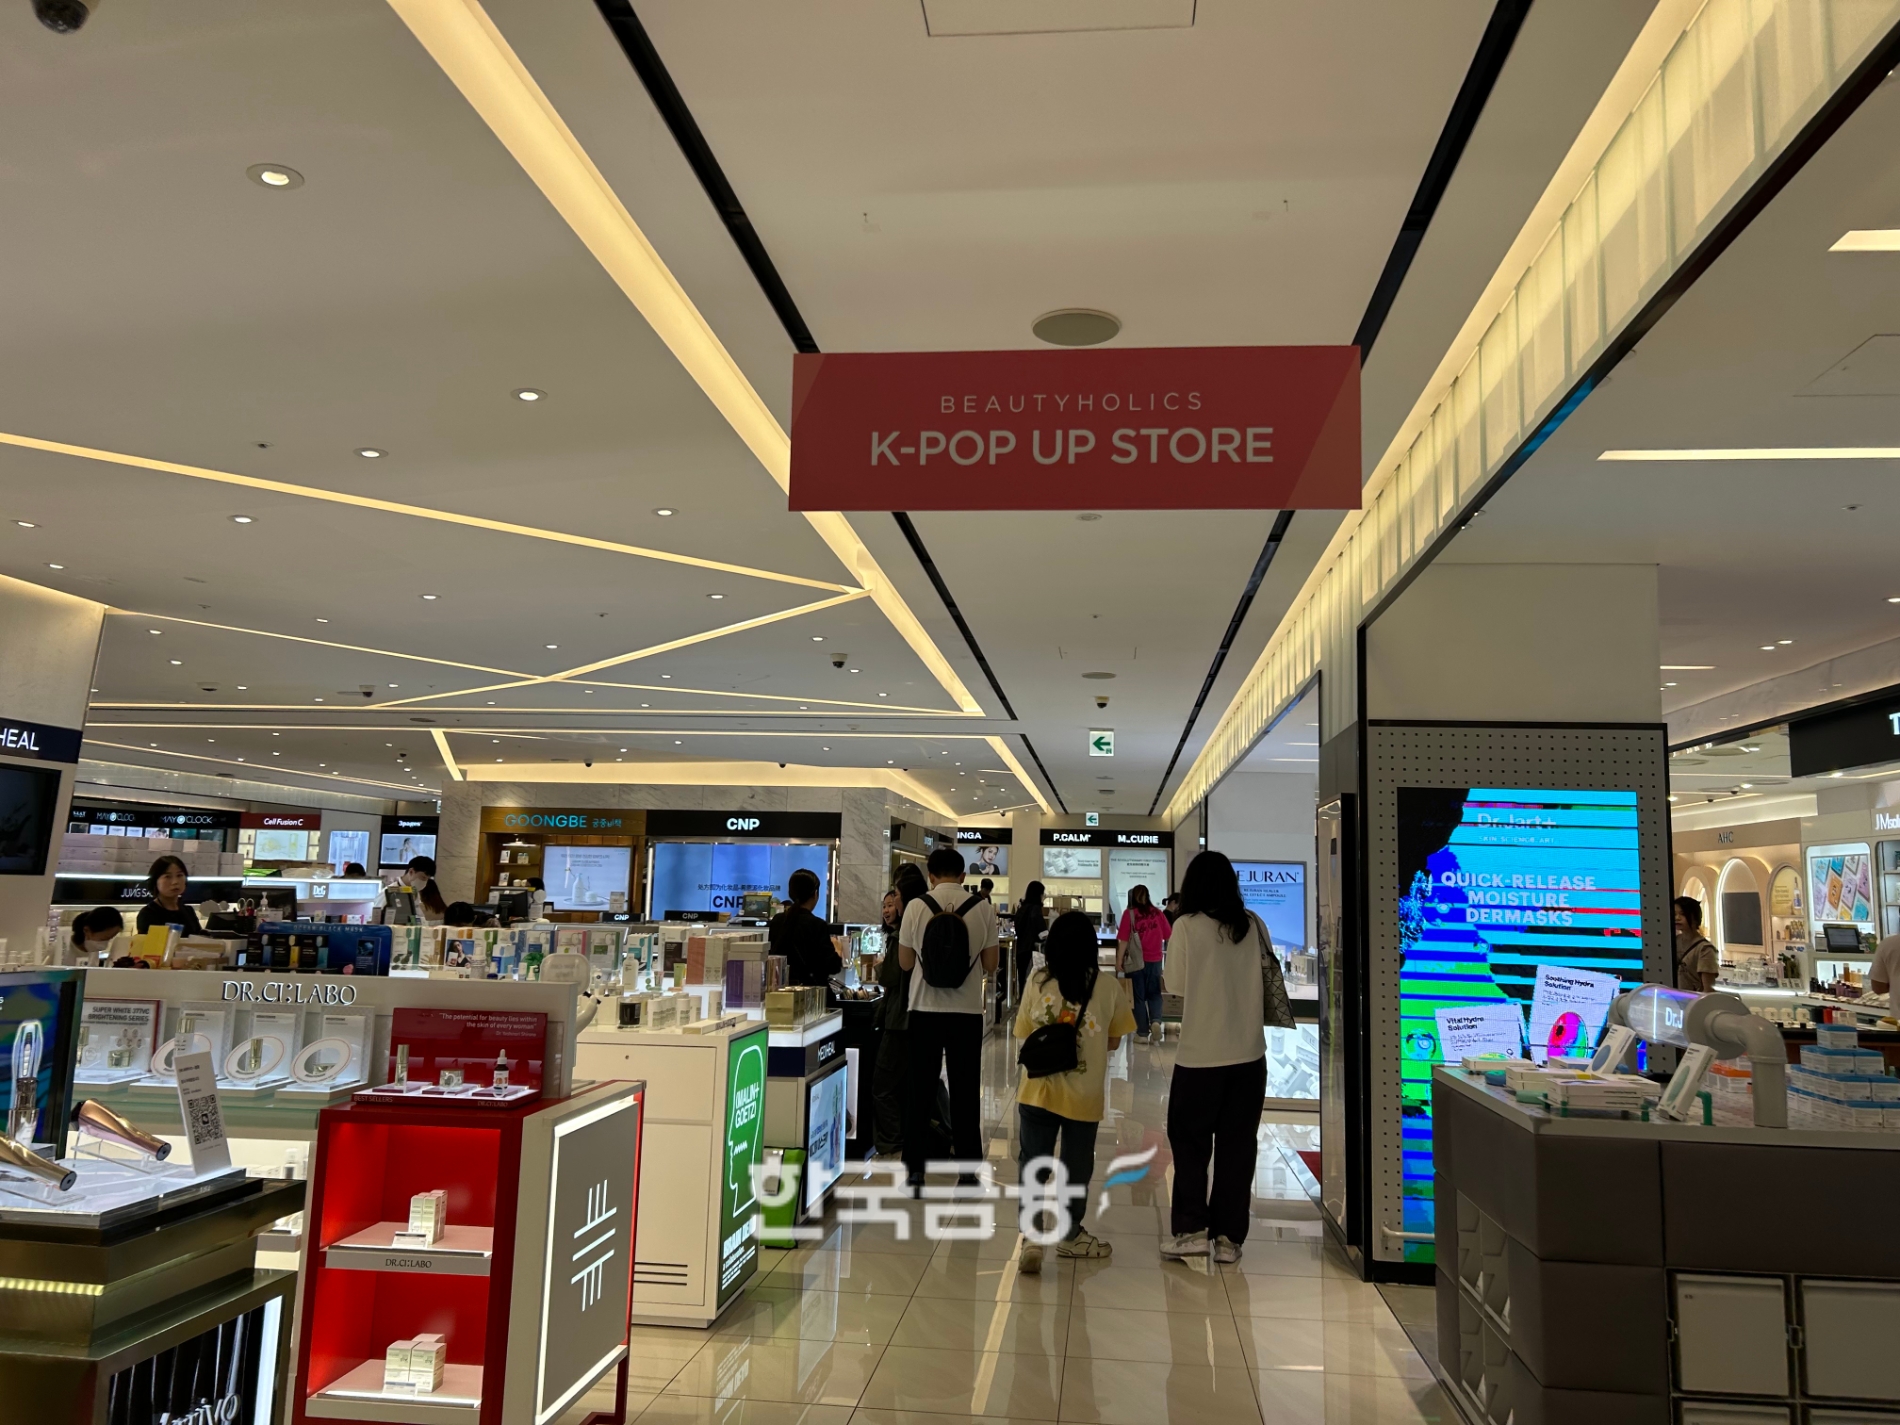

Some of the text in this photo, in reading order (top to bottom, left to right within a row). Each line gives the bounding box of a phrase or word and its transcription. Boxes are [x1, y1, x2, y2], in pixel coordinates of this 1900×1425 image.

[941, 392, 1202, 413] BEAUTYHOLICS
[871, 427, 1274, 466] K-POP UP STORE
[263, 817, 304, 826] Cell Fusion C
[504, 814, 588, 828] GOONGBE
[592, 818, 622, 828] 궁중비책
[726, 818, 760, 831] CNP
[1053, 833, 1091, 842] P.CALM
[1718, 831, 1734, 844] AHC
[1441, 872, 1596, 890] QUICK-RELEASE
[1468, 891, 1569, 908] MOISTURE
[1466, 908, 1573, 926] DERMASKS
[222, 980, 357, 1005] DR.CI:LABO
[1544, 981, 1571, 991] Solution
[488, 1015, 507, 1023] beauty
[385, 1258, 432, 1268] DR.CI:LABO
